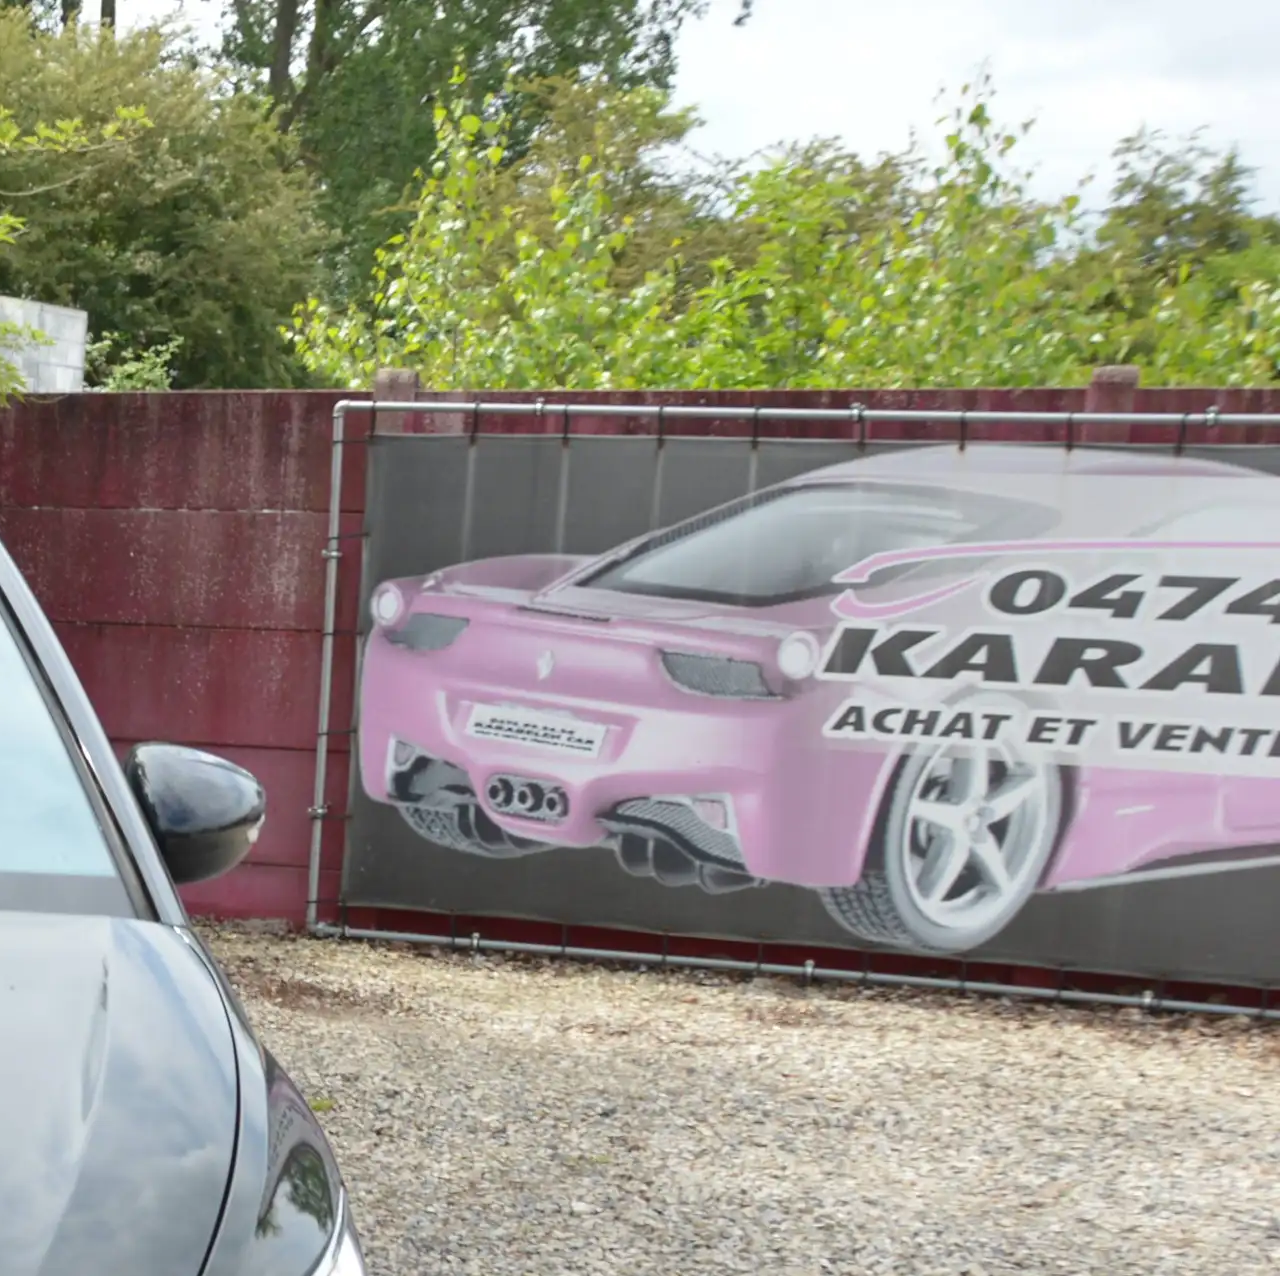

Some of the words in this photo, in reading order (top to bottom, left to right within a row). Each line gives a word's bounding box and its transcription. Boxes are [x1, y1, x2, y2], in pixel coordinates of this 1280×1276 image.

[823, 627, 1280, 696] KARA
[830, 705, 1012, 740] ACHAT
[1028, 716, 1097, 746] ET
